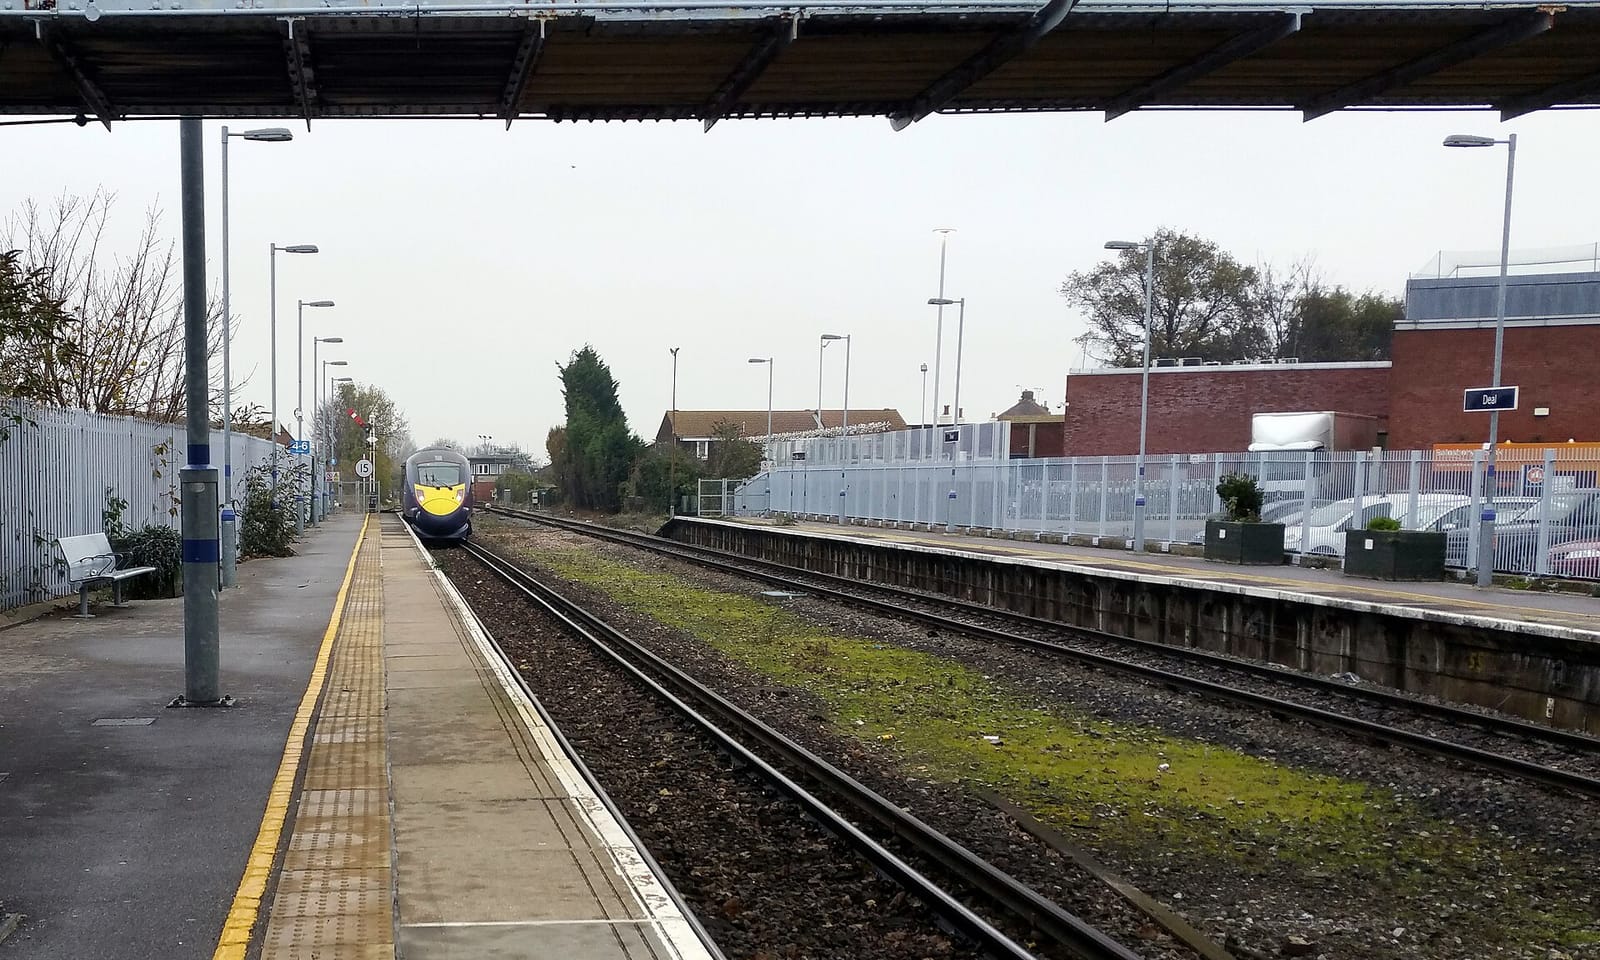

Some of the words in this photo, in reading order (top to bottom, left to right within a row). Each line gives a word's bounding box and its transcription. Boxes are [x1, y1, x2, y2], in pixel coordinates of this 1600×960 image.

[1482, 394, 1497, 405] Deal
[292, 441, 308, 451] 4-6
[360, 463, 369, 473] 15
